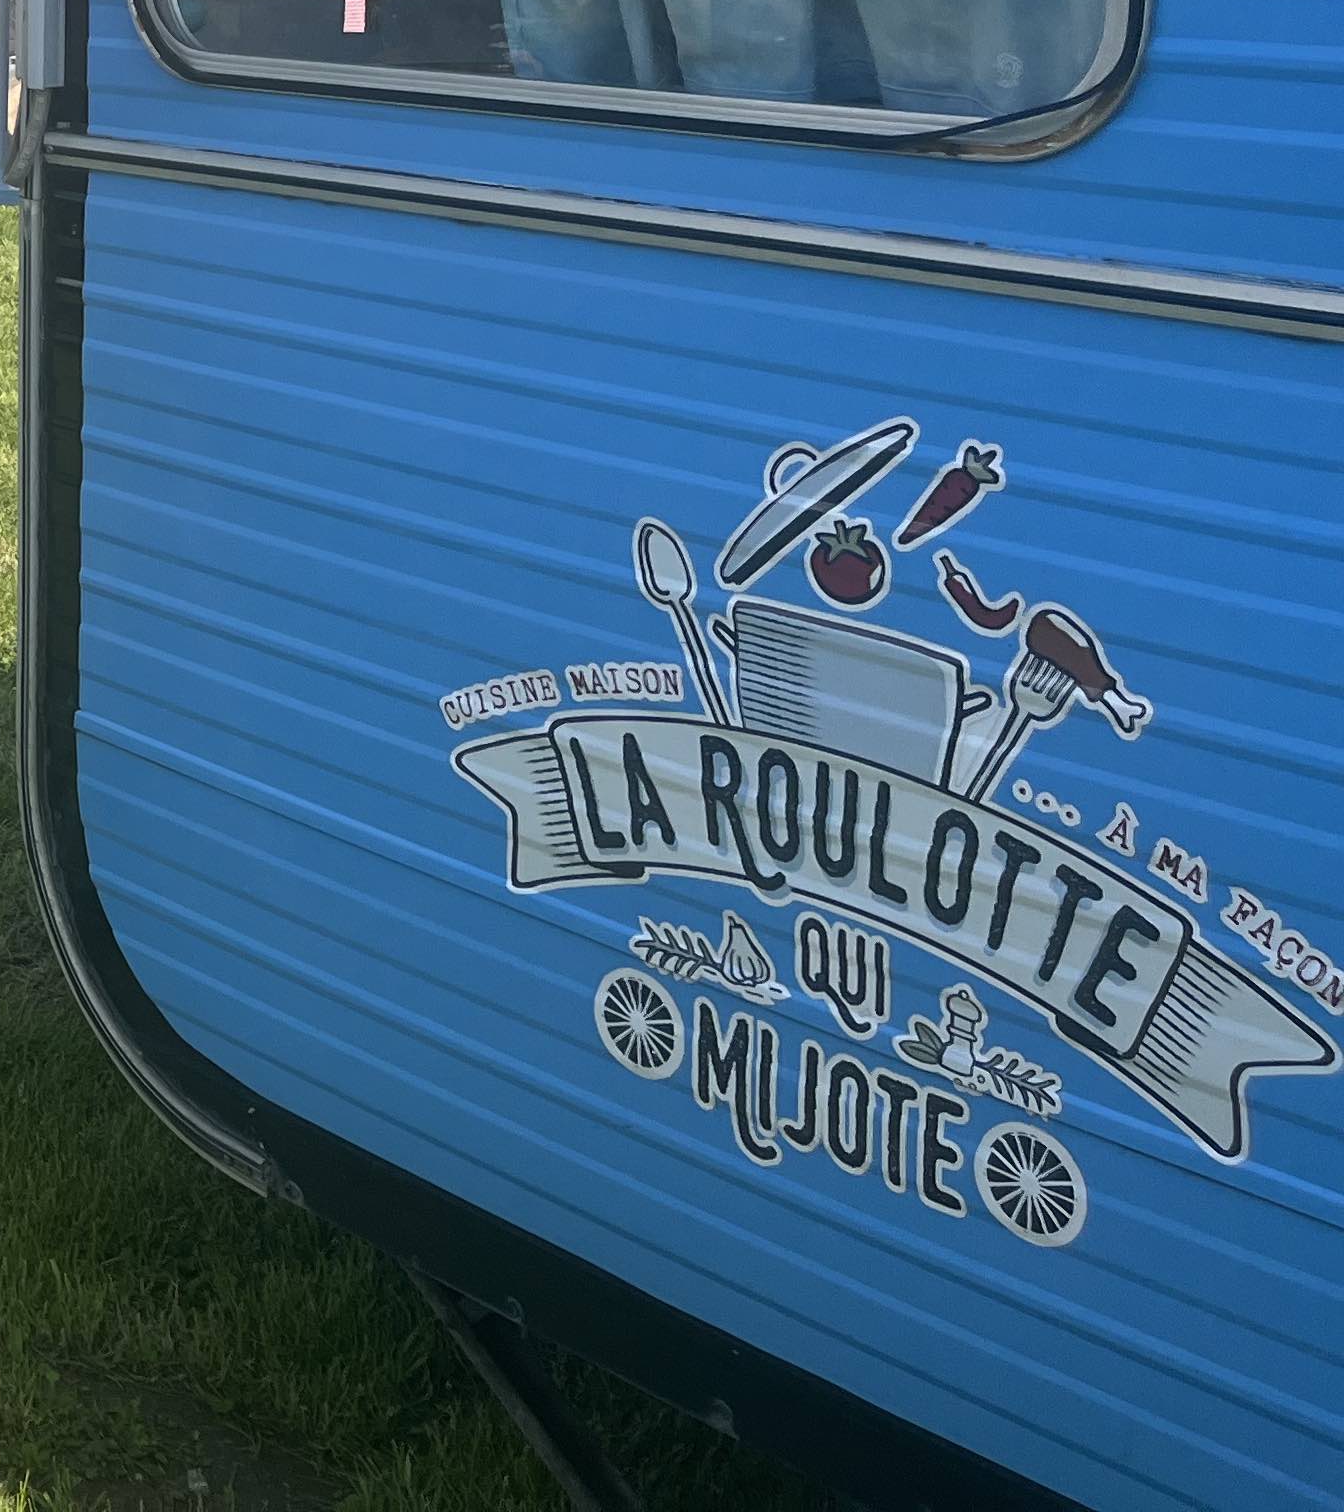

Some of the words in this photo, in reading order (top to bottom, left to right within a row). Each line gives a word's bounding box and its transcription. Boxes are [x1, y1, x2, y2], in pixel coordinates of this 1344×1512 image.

[443, 674, 558, 725] CUISINE
[568, 667, 680, 697] MAISON
[573, 731, 676, 848] LA
[700, 733, 1162, 1029] ROULOTTE
[801, 918, 885, 1032] QUI
[1105, 807, 1131, 850] À
[1155, 844, 1202, 897] MA
[1226, 893, 1344, 1008] FAÇON
[698, 1001, 968, 1212] MIJOTE
